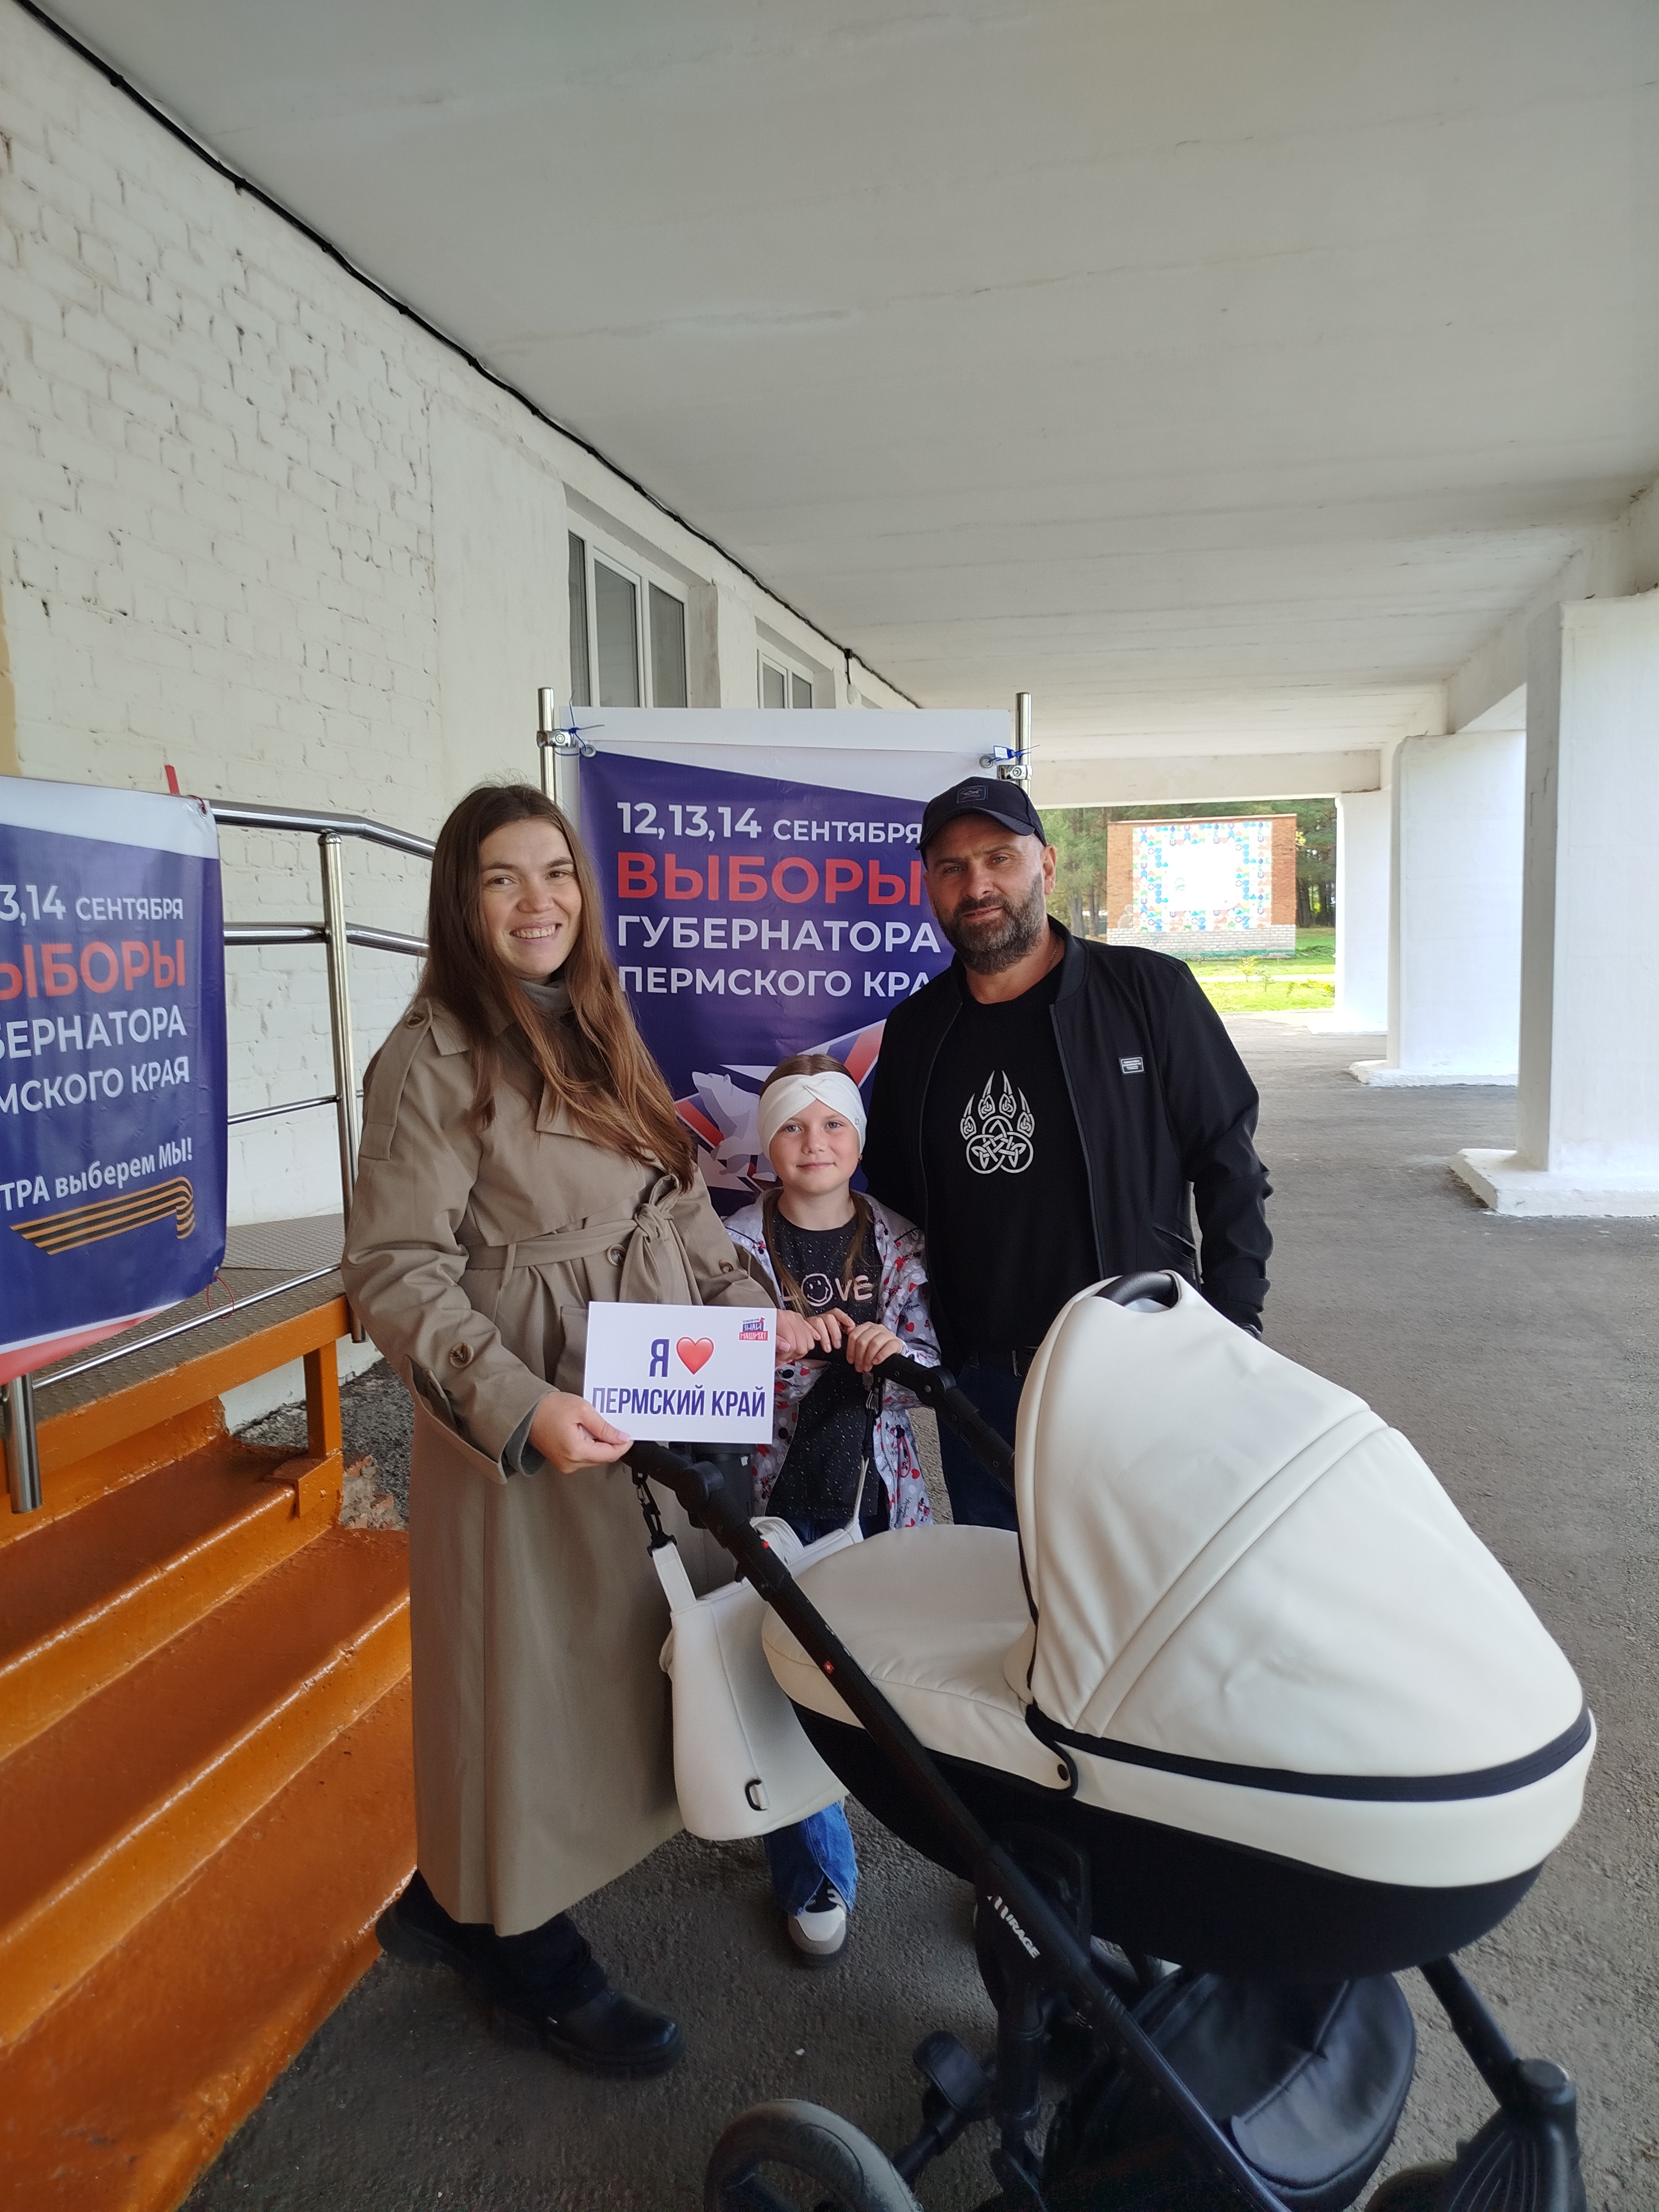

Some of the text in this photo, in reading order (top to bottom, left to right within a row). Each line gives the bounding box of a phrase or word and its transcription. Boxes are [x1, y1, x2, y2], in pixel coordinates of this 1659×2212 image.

[617, 801, 922, 844] 12,13,14 СЕНТЯБРЯ
[617, 851, 922, 906] ВЫБОРЫ
[0, 884, 184, 926] 3,14 СЕНТЯБРЯ
[618, 915, 941, 953] ГУБЕРНАТОРА
[0, 939, 186, 1000] ЫБОРЫ
[618, 966, 930, 998] ПЕРМСКОГО КРА
[0, 1056, 190, 1115] МСКОГО КРАЯ
[0, 1136, 193, 1211] ТРА выберем МЫ!
[740, 1331, 766, 1340] НАШИХ!
[649, 1338, 670, 1378] Я
[592, 1384, 766, 1417] ПЕРМСКИЙ КРАЙ
